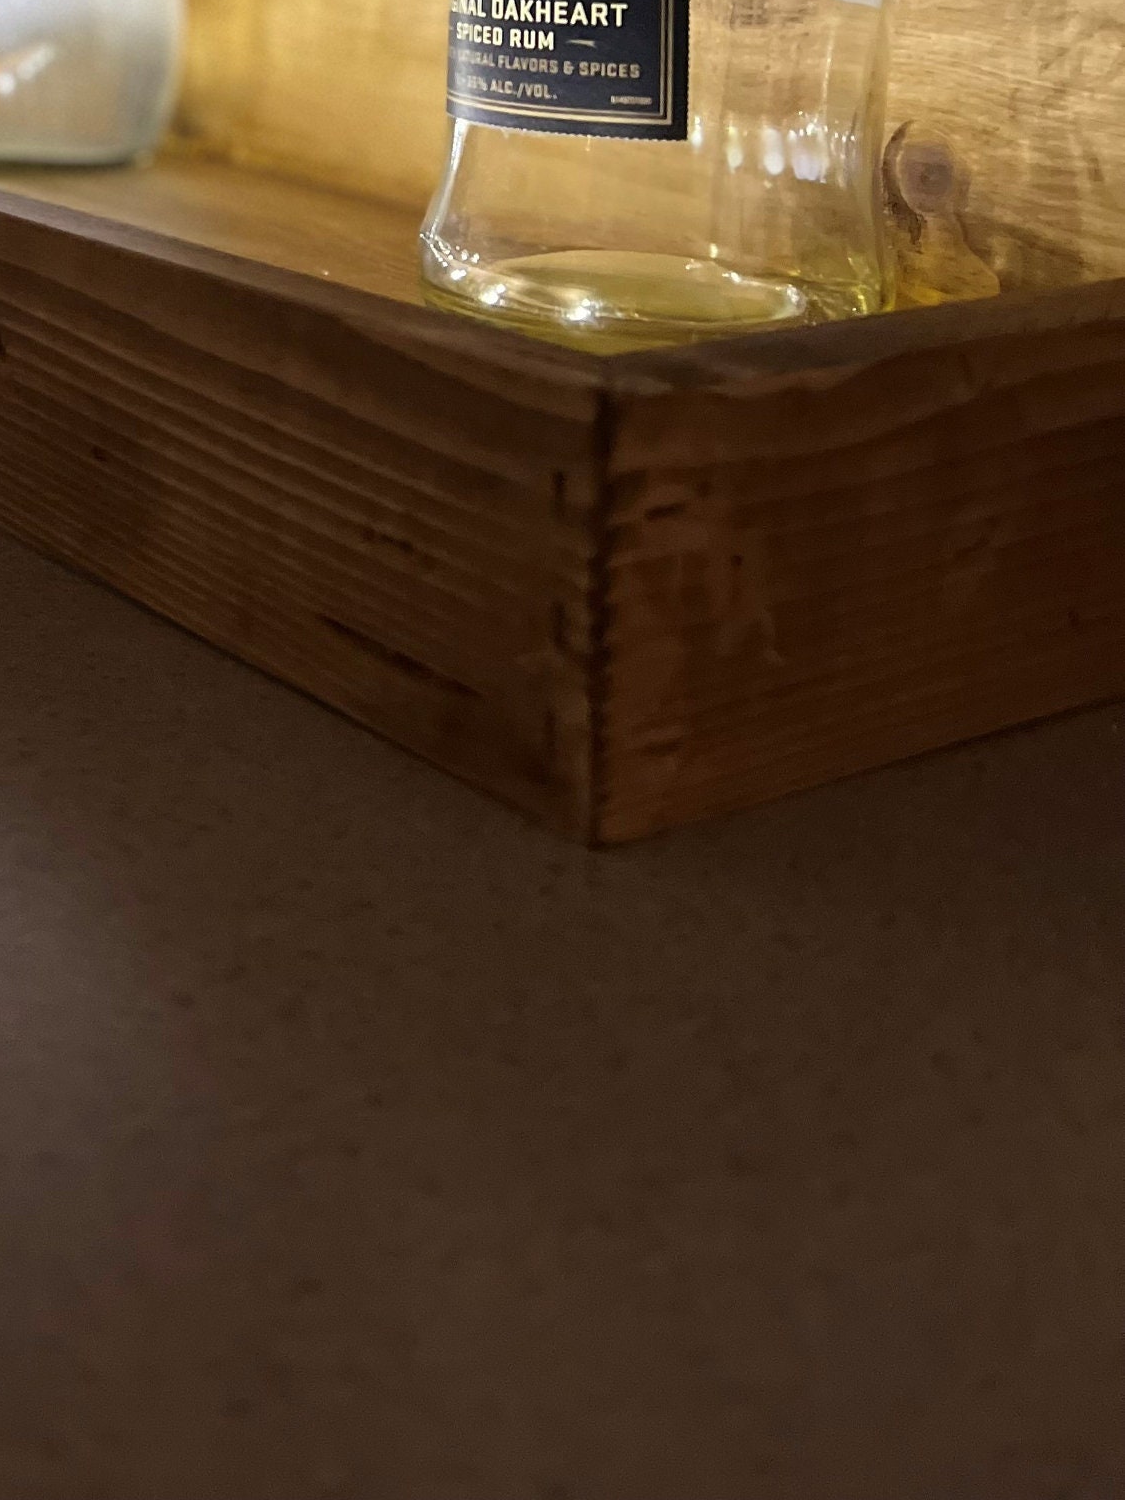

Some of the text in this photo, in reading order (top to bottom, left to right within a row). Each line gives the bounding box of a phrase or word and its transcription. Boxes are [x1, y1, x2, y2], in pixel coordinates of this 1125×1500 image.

[456, 21, 555, 51] SPICED RUM
[497, 54, 559, 75] FLAVORS
[563, 62, 575, 76] &
[578, 62, 641, 79] SPICES
